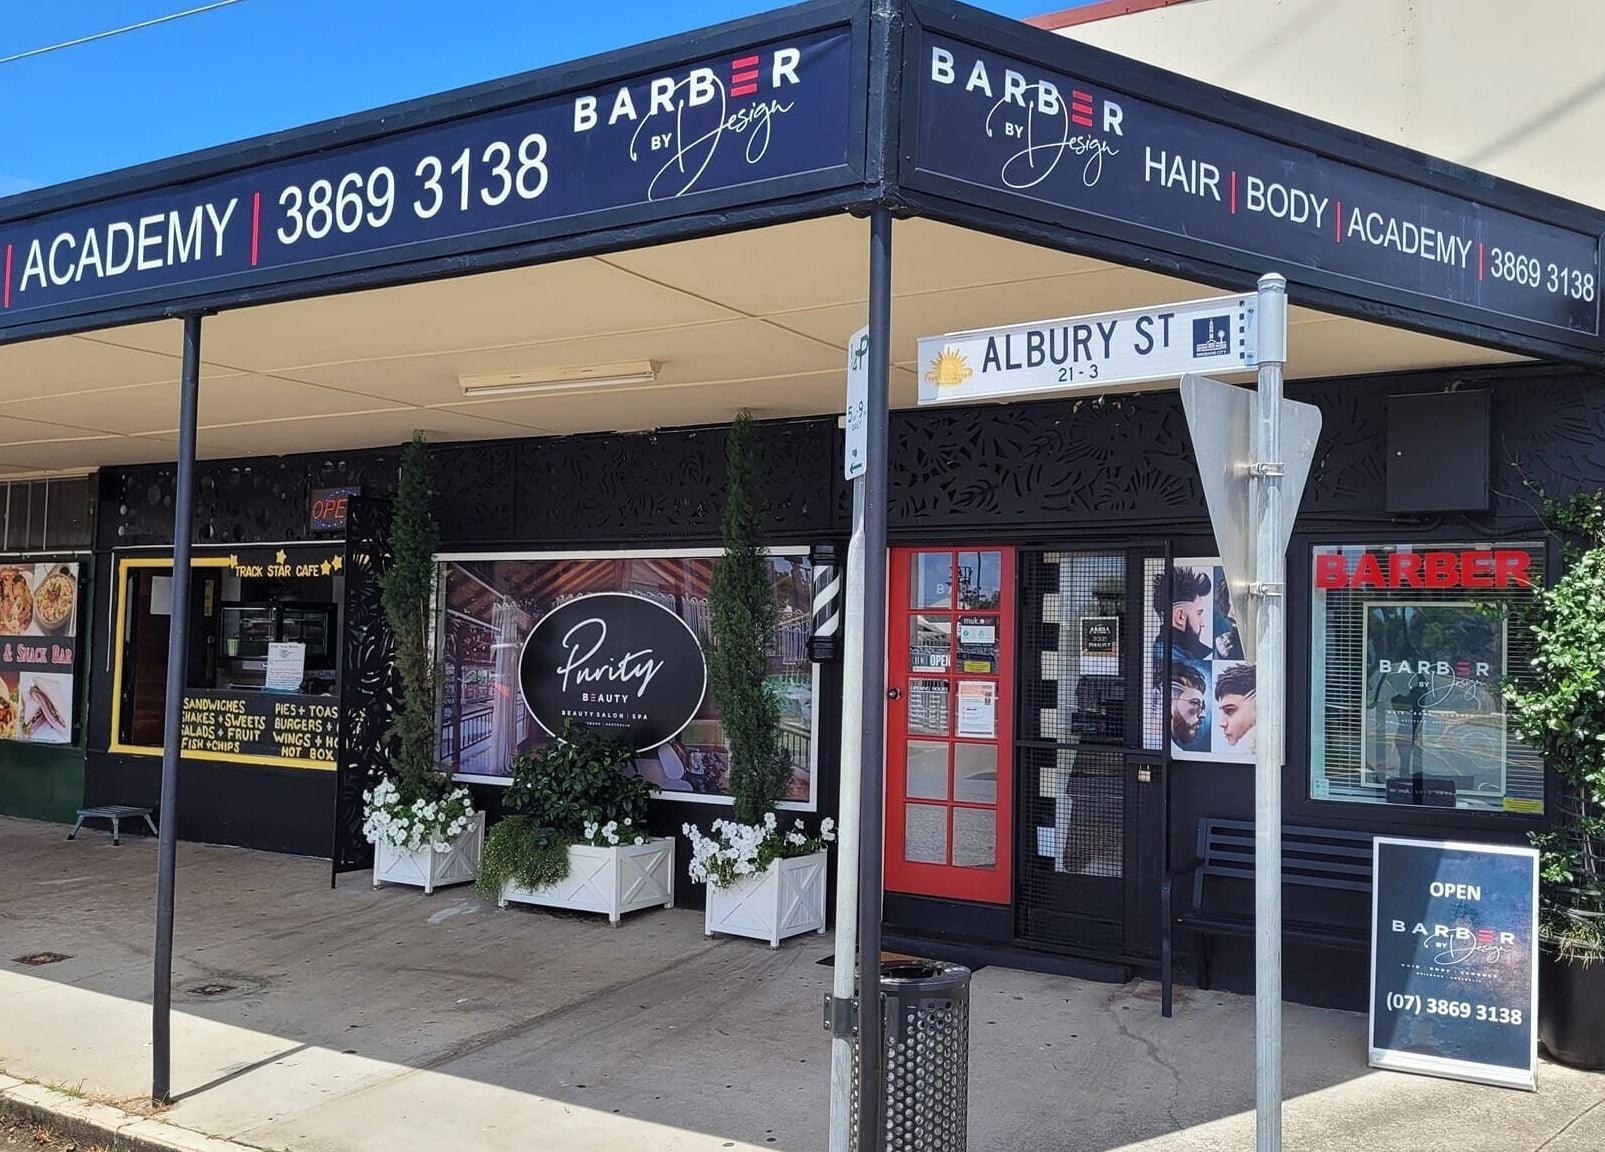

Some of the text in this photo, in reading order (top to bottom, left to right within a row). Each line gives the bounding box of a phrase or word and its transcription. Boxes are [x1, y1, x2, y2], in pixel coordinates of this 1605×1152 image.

[573, 47, 802, 134] BARBER
[932, 46, 1124, 137] BARBER
[630, 69, 796, 201] BY Design
[986, 84, 1120, 190] BY Design
[20, 133, 549, 291] ACADEMY 3869 3138
[1144, 146, 1595, 303] HAIR BODY ACADEMY 3869 3138
[981, 313, 1175, 373] ALBURY ST
[312, 498, 348, 519] OPE
[235, 564, 319, 577] TRACK STAR CAFE
[1315, 550, 1532, 590] BARBER
[3, 643, 13, 662] &
[52, 644, 73, 664] BAR
[556, 617, 665, 698] Purity
[1379, 659, 1490, 677] BARBER
[183, 697, 246, 714] SANDWICHES
[582, 692, 629, 704] BEAUTY
[275, 703, 297, 716] PIES
[309, 705, 339, 719] TOAS
[561, 709, 594, 717] BEAUTY
[596, 711, 624, 719] SALON
[227, 728, 261, 742] FRUIT
[274, 717, 323, 733] BURGERS
[181, 737, 202, 750] FISH
[273, 731, 311, 747] WINGS
[326, 736, 339, 749] HO
[281, 746, 335, 761] HOT BOX
[1429, 881, 1481, 902] OPEN
[1392, 920, 1515, 945] BARBER
[1423, 928, 1513, 965] BY Design
[1386, 992, 1522, 1026] (07) 3869 3138
